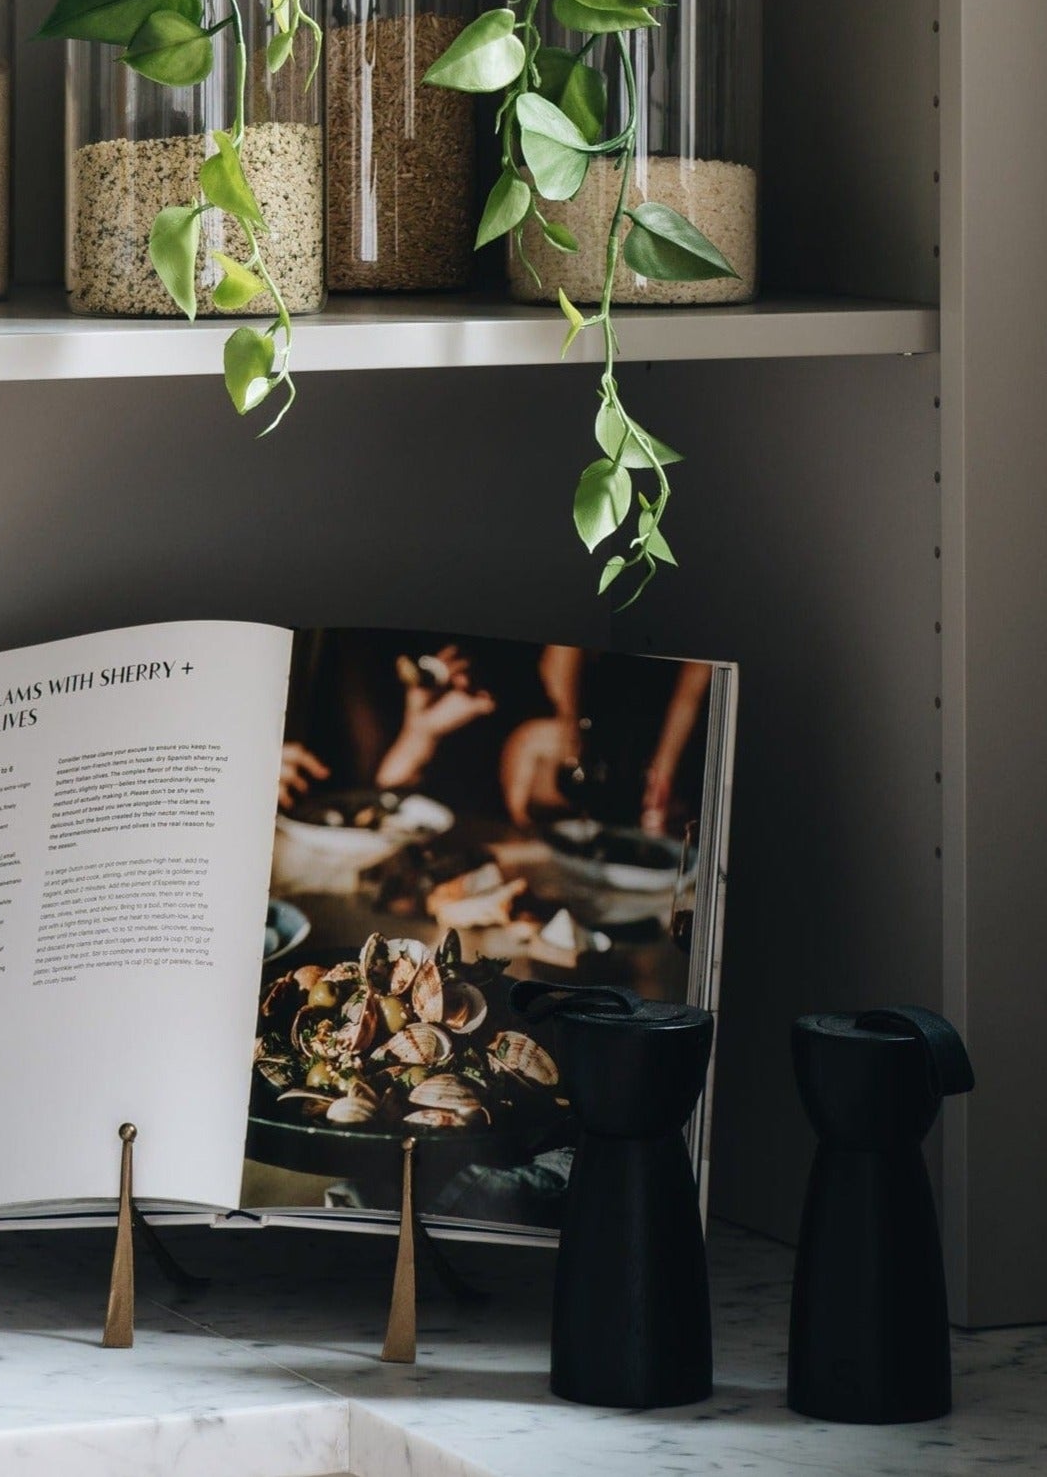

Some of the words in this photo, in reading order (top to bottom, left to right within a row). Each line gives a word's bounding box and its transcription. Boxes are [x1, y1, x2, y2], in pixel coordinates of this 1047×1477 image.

[48, 672, 94, 694] WITH
[99, 660, 176, 686] SHERRY
[182, 662, 194, 674] +
[58, 755, 80, 764] Consider
[56, 766, 79, 774] essential
[81, 761, 111, 770] non-French
[79, 784, 98, 793] slightly
[53, 798, 73, 807] method
[62, 808, 81, 816] amount
[59, 827, 101, 838] aforementioned
